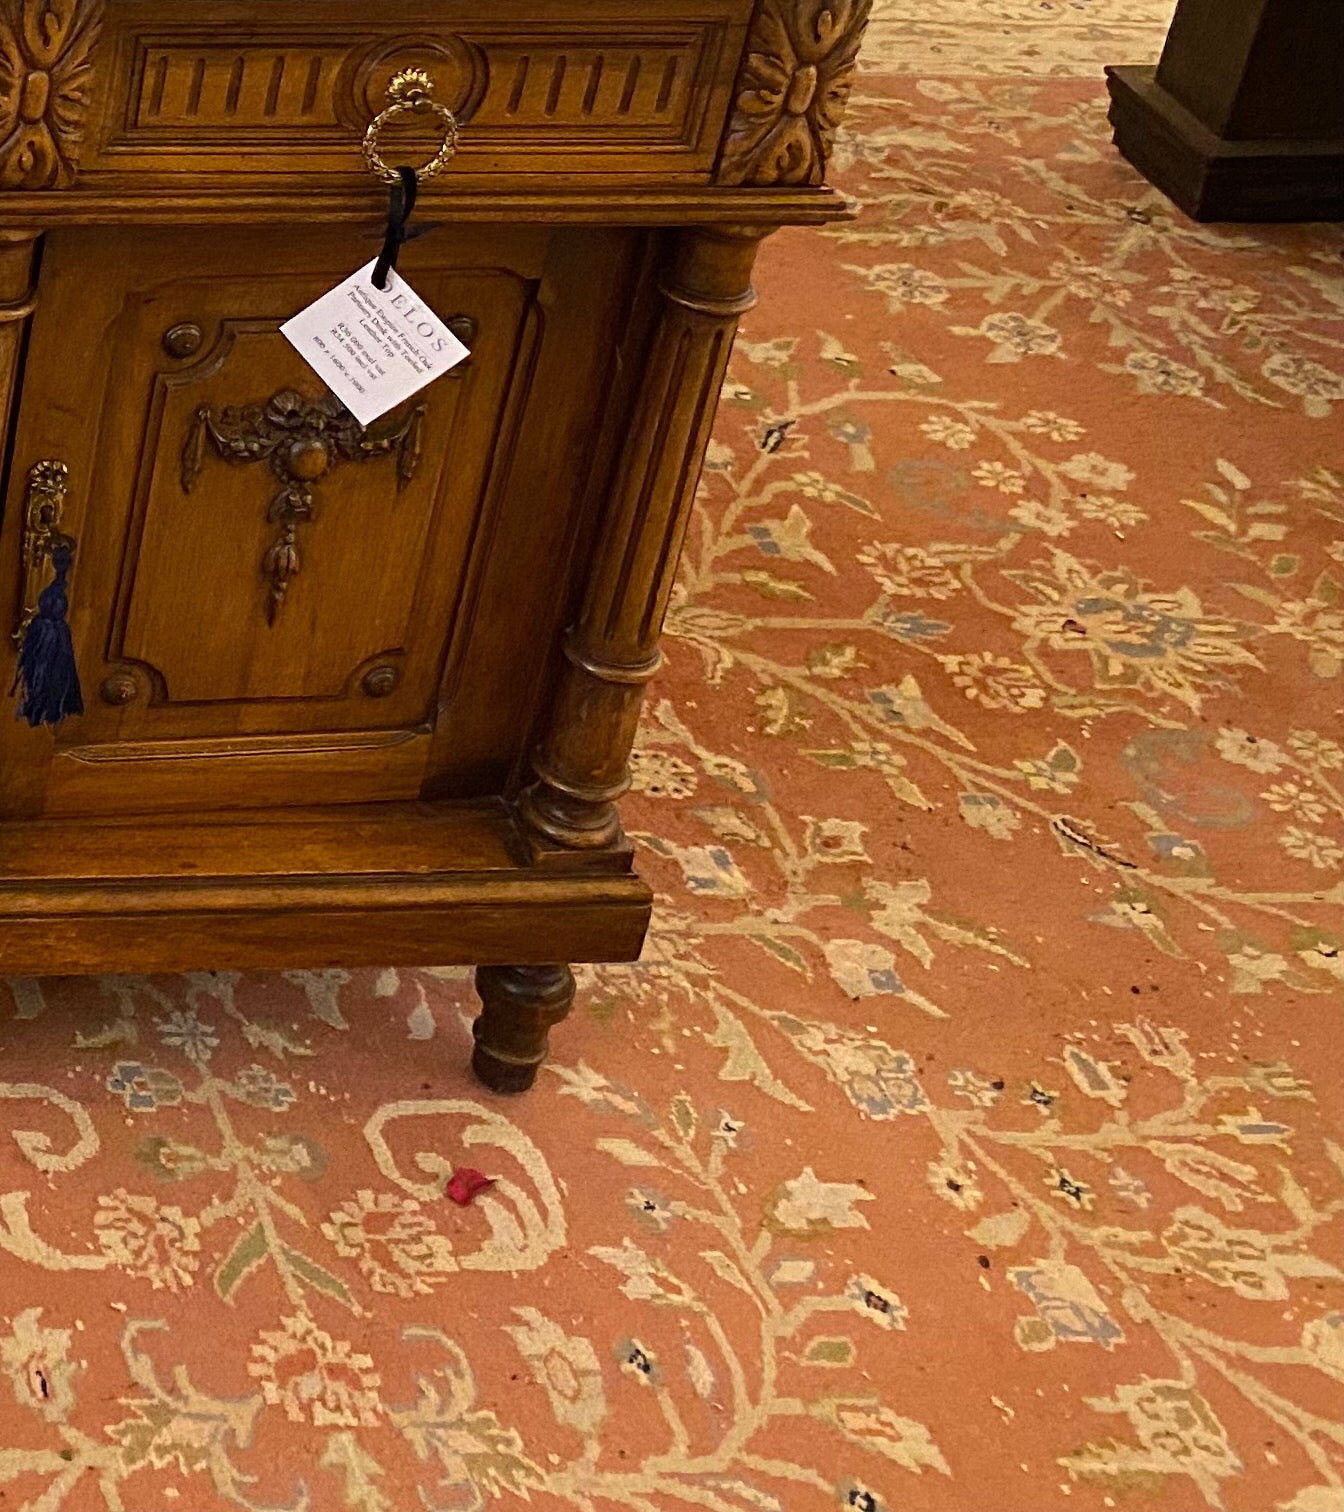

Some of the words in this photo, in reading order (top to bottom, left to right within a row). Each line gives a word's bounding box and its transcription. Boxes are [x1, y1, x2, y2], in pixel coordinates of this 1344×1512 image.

[353, 283, 377, 310] Antique
[397, 332, 420, 356] French
[418, 354, 433, 370] Oak
[358, 318, 382, 343] Leather
[381, 343, 394, 358] Top
[370, 317, 388, 335] Desk
[386, 335, 402, 350] with
[366, 369, 377, 380] vat
